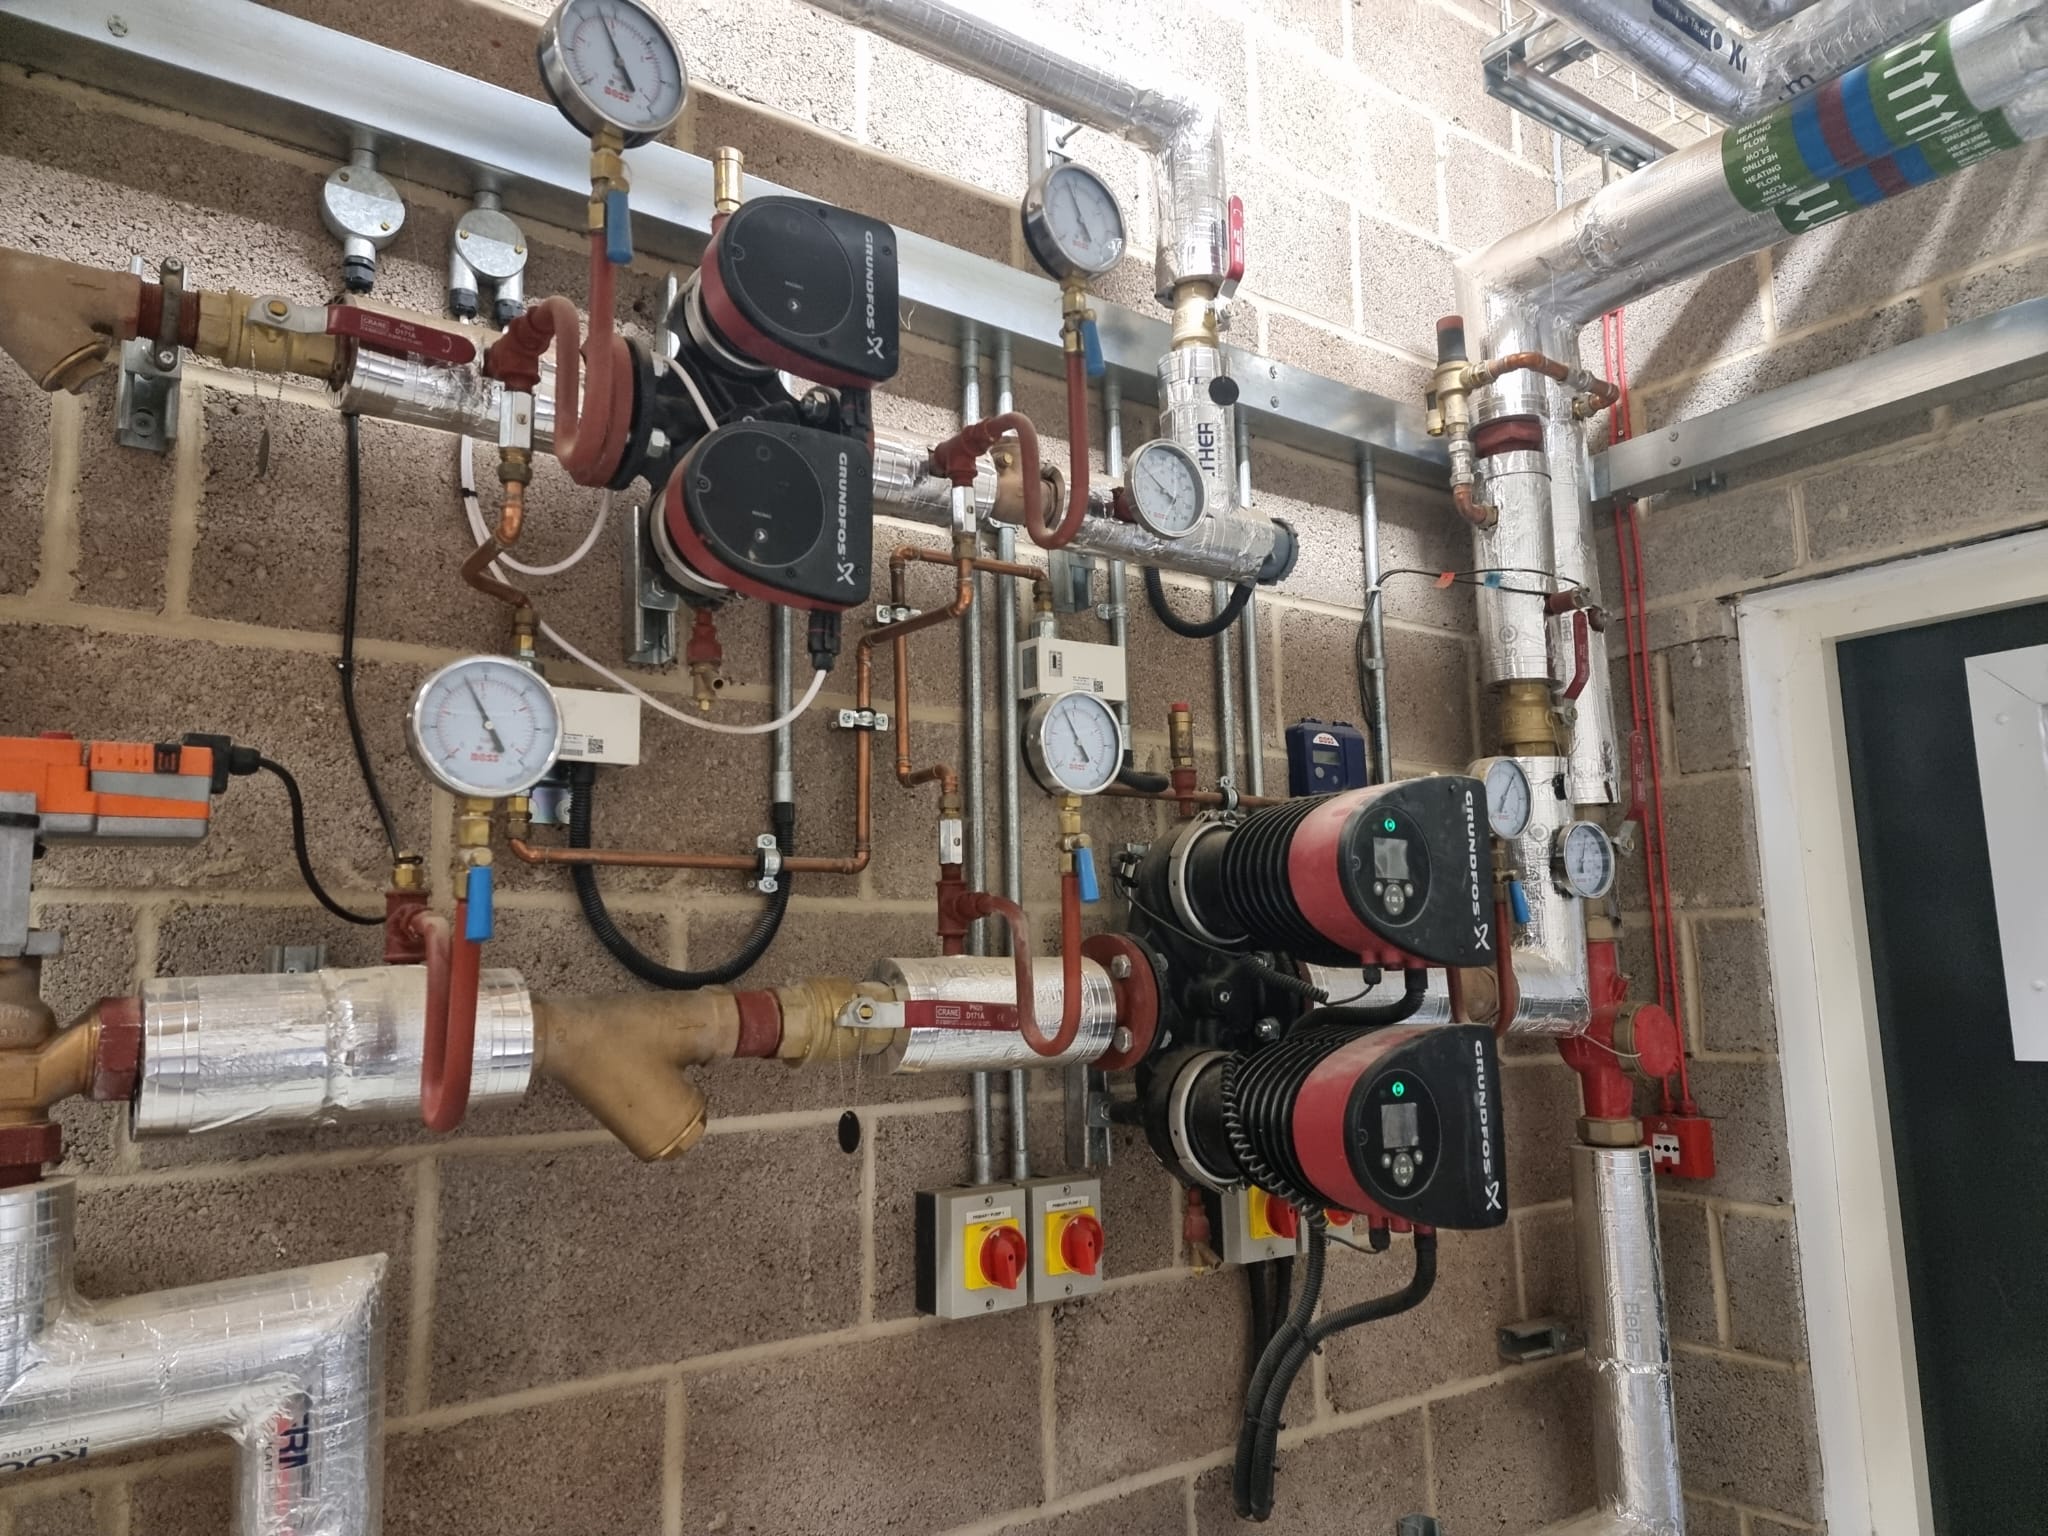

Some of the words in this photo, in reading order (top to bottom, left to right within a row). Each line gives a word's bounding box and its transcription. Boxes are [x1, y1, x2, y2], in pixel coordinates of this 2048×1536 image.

[1736, 122, 1772, 145] HEATING
[1743, 133, 1768, 150] FLOW
[1741, 152, 1779, 174] HEATING
[1745, 145, 1770, 162] FLOW
[1745, 163, 1782, 185] HEATING
[1755, 174, 1781, 189] FLOW
[865, 230, 875, 330] GRUNDFOS
[837, 452, 848, 556] GRUNDFOS
[1465, 790, 1481, 916] GRUNDFOS
[937, 1007, 960, 1017] CRANE
[966, 1010, 985, 1020] D171A
[1474, 1040, 1491, 1175] GRUNDFOS
[48, 1436, 89, 1450] NEXT
